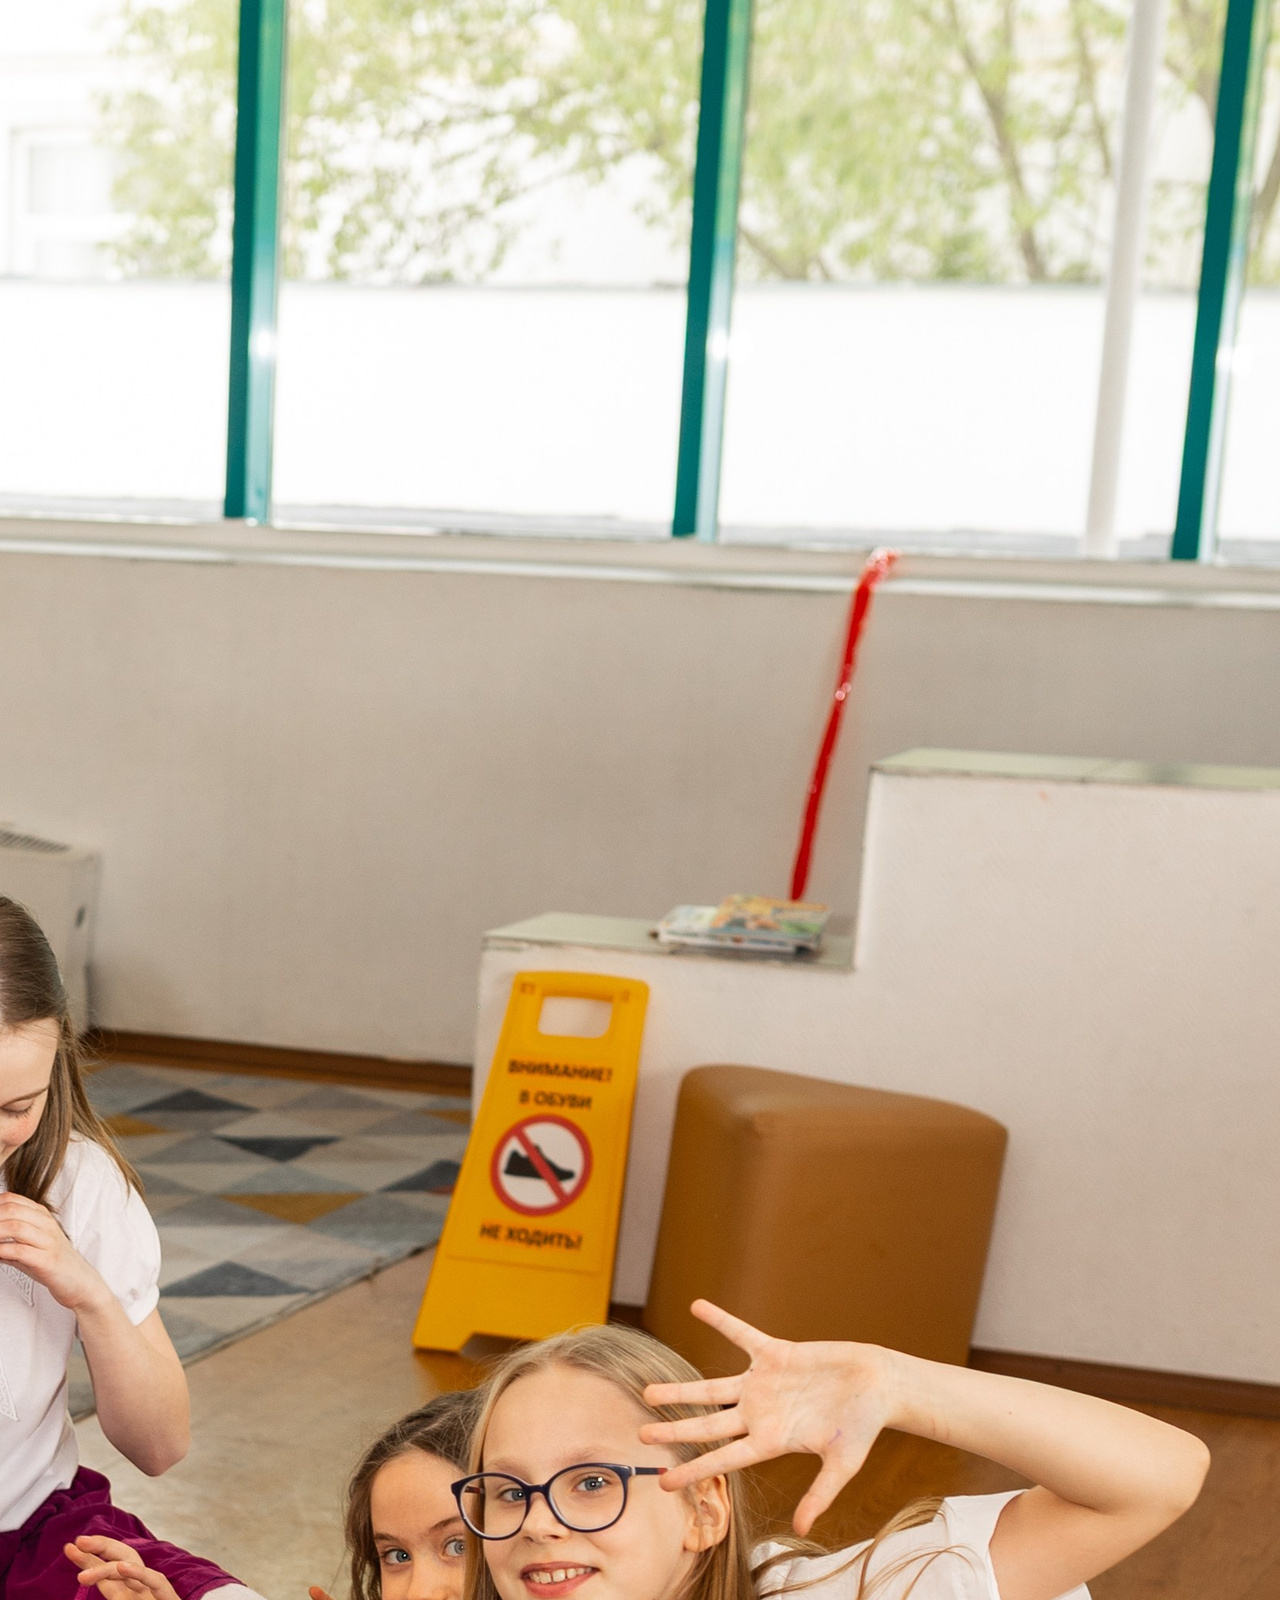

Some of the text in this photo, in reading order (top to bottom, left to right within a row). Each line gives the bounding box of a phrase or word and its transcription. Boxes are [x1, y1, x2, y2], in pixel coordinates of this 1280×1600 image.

[508, 1059, 613, 1082] ВНИМАНИЕ!
[519, 1089, 592, 1110] В ОБУВИ
[480, 1223, 583, 1251] НЕ ХОДИТЬ!
